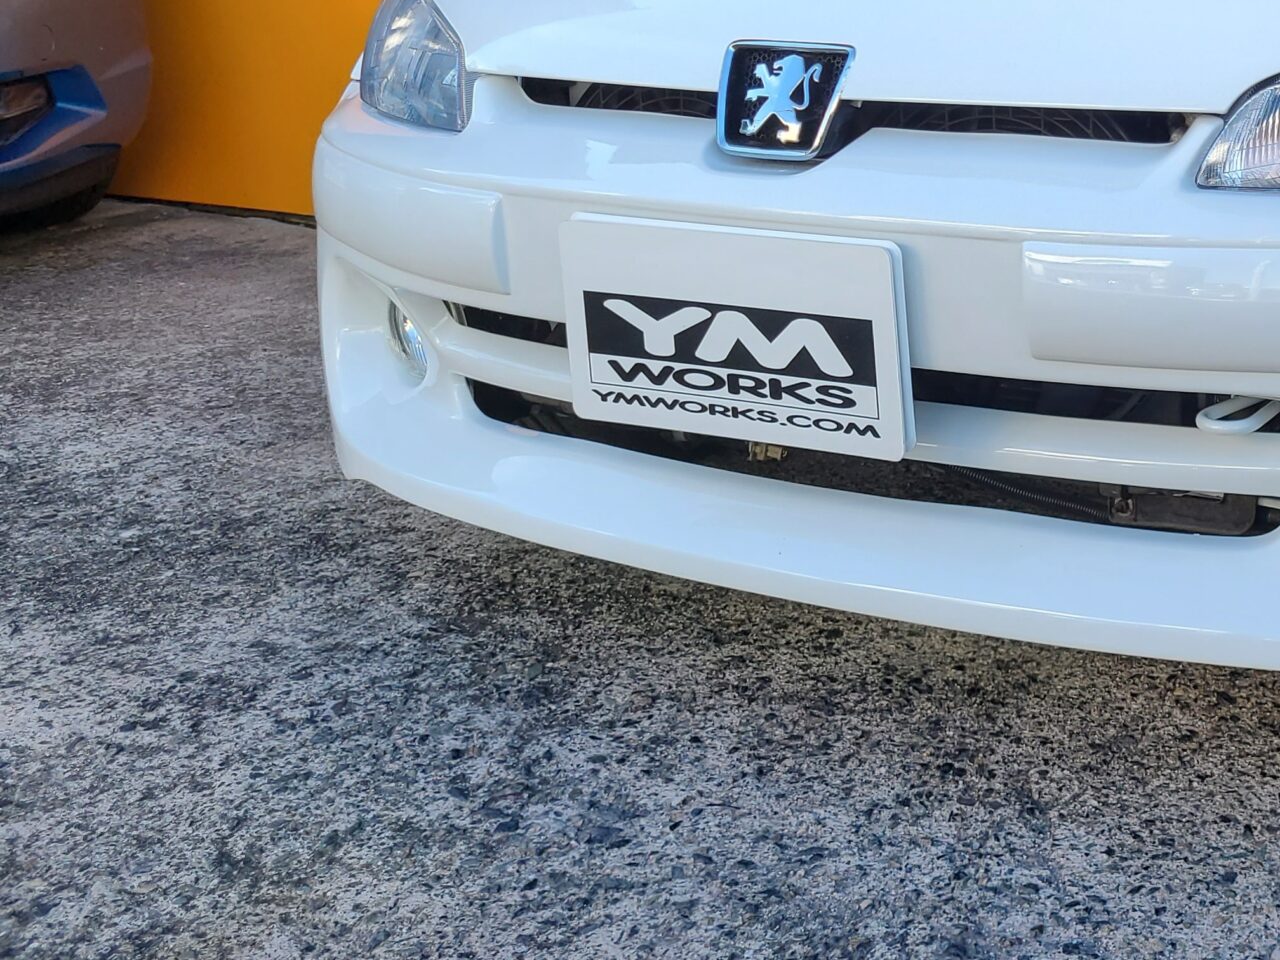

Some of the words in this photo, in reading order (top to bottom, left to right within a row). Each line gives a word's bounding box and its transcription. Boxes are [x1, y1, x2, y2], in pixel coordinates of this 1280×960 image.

[603, 298, 854, 378] YM
[607, 359, 857, 409] WORKS
[592, 388, 881, 439] YMWORKS.COM
